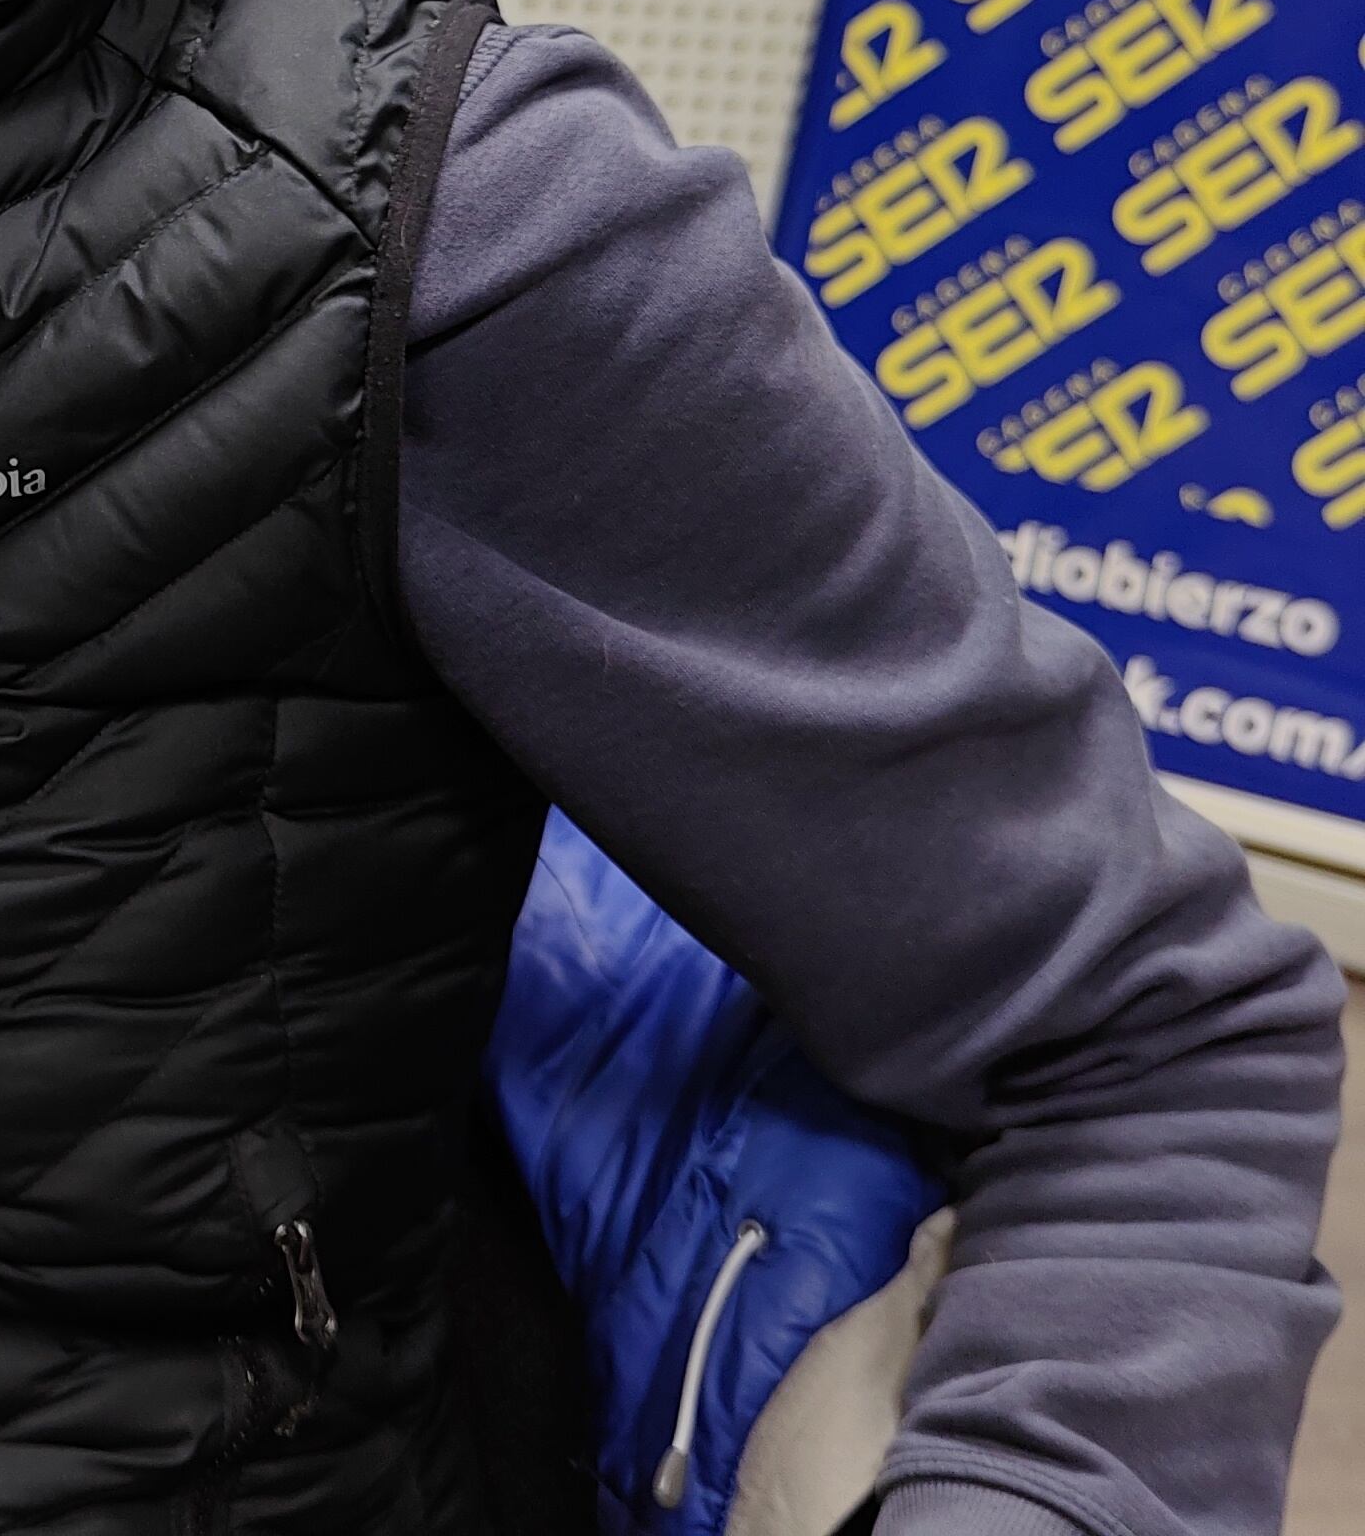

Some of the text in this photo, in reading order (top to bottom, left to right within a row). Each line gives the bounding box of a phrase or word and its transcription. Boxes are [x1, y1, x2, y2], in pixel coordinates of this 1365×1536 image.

[806, 116, 1036, 308] SER
[1112, 76, 1365, 277] SER
[876, 237, 1123, 430] SER
